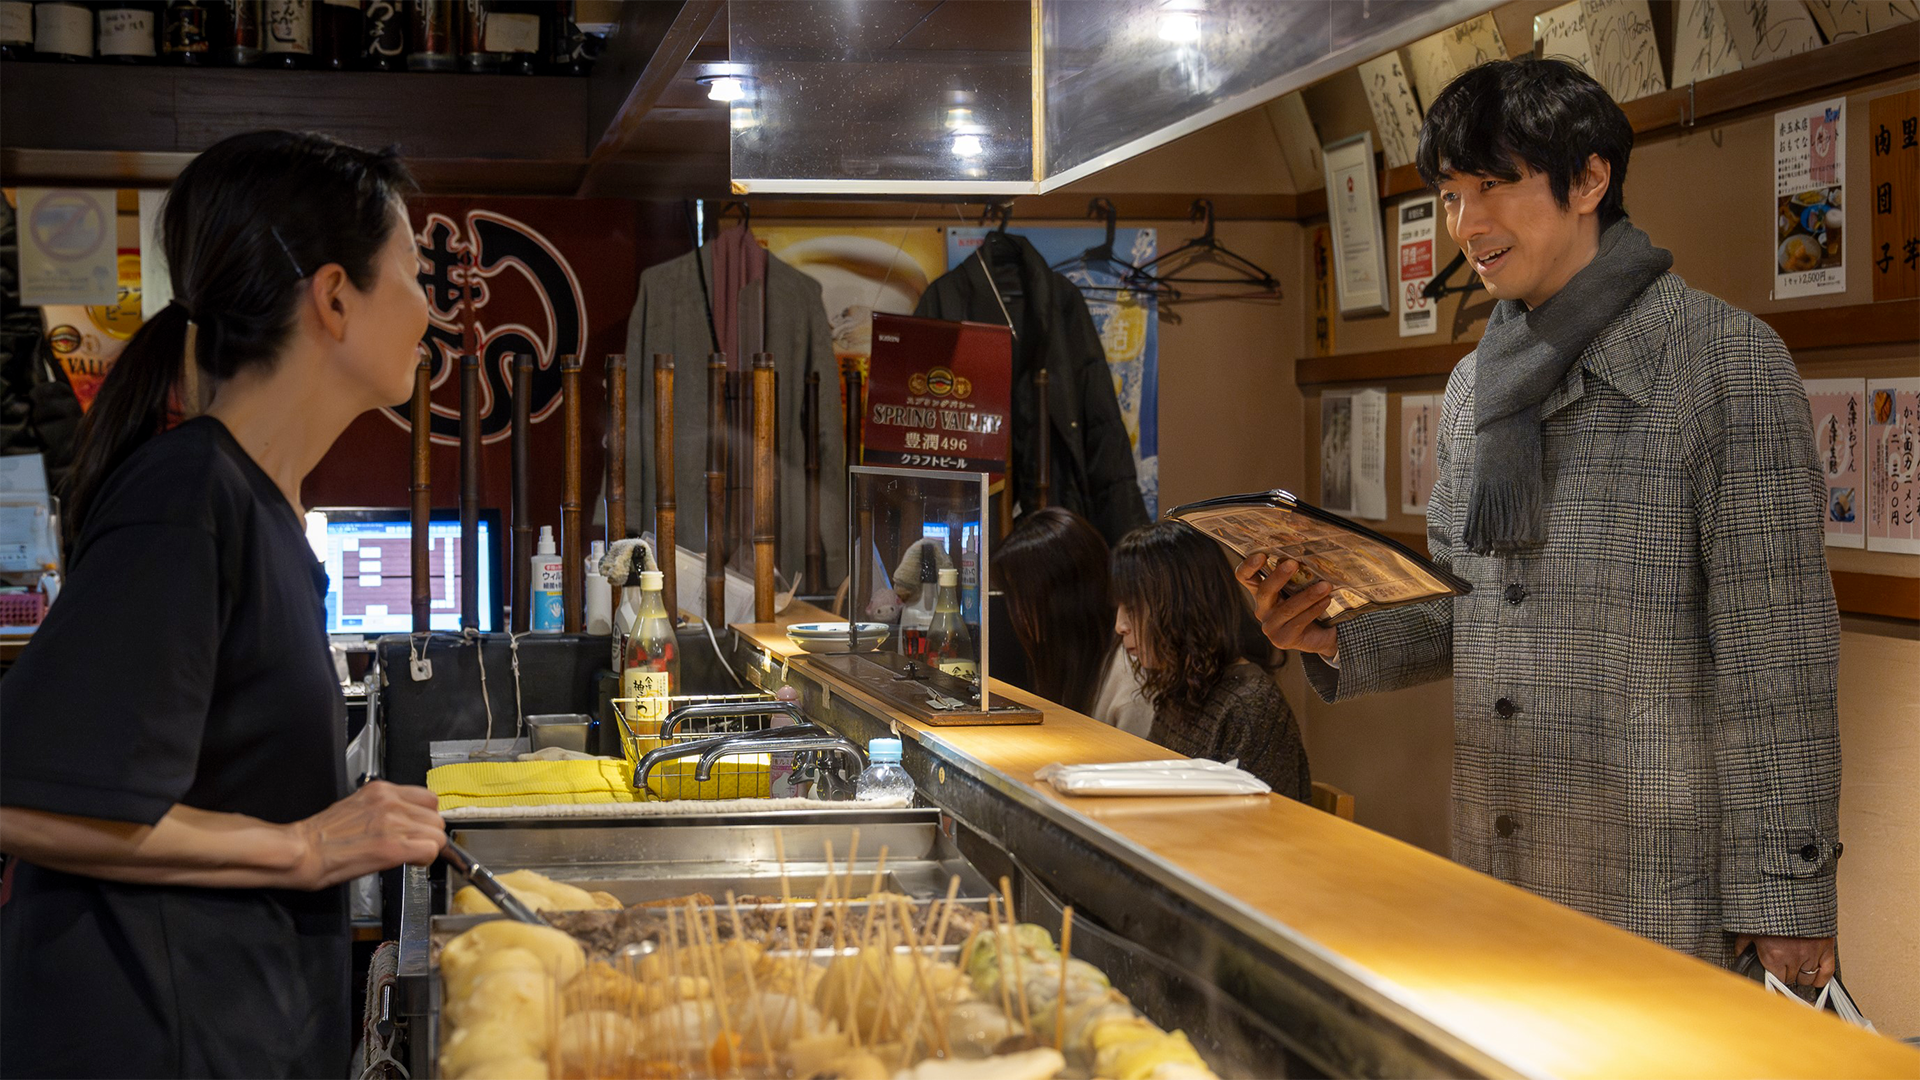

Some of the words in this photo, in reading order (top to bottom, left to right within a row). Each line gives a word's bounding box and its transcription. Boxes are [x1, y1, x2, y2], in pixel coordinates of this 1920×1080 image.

[1875, 124, 1894, 274] 肉団子
[1902, 116, 1920, 271] 里芋
[873, 403, 936, 429] SPRING
[939, 410, 1003, 434] VALLEY
[904, 432, 968, 451] 豊潤496
[901, 453, 968, 469] クラフトビール
